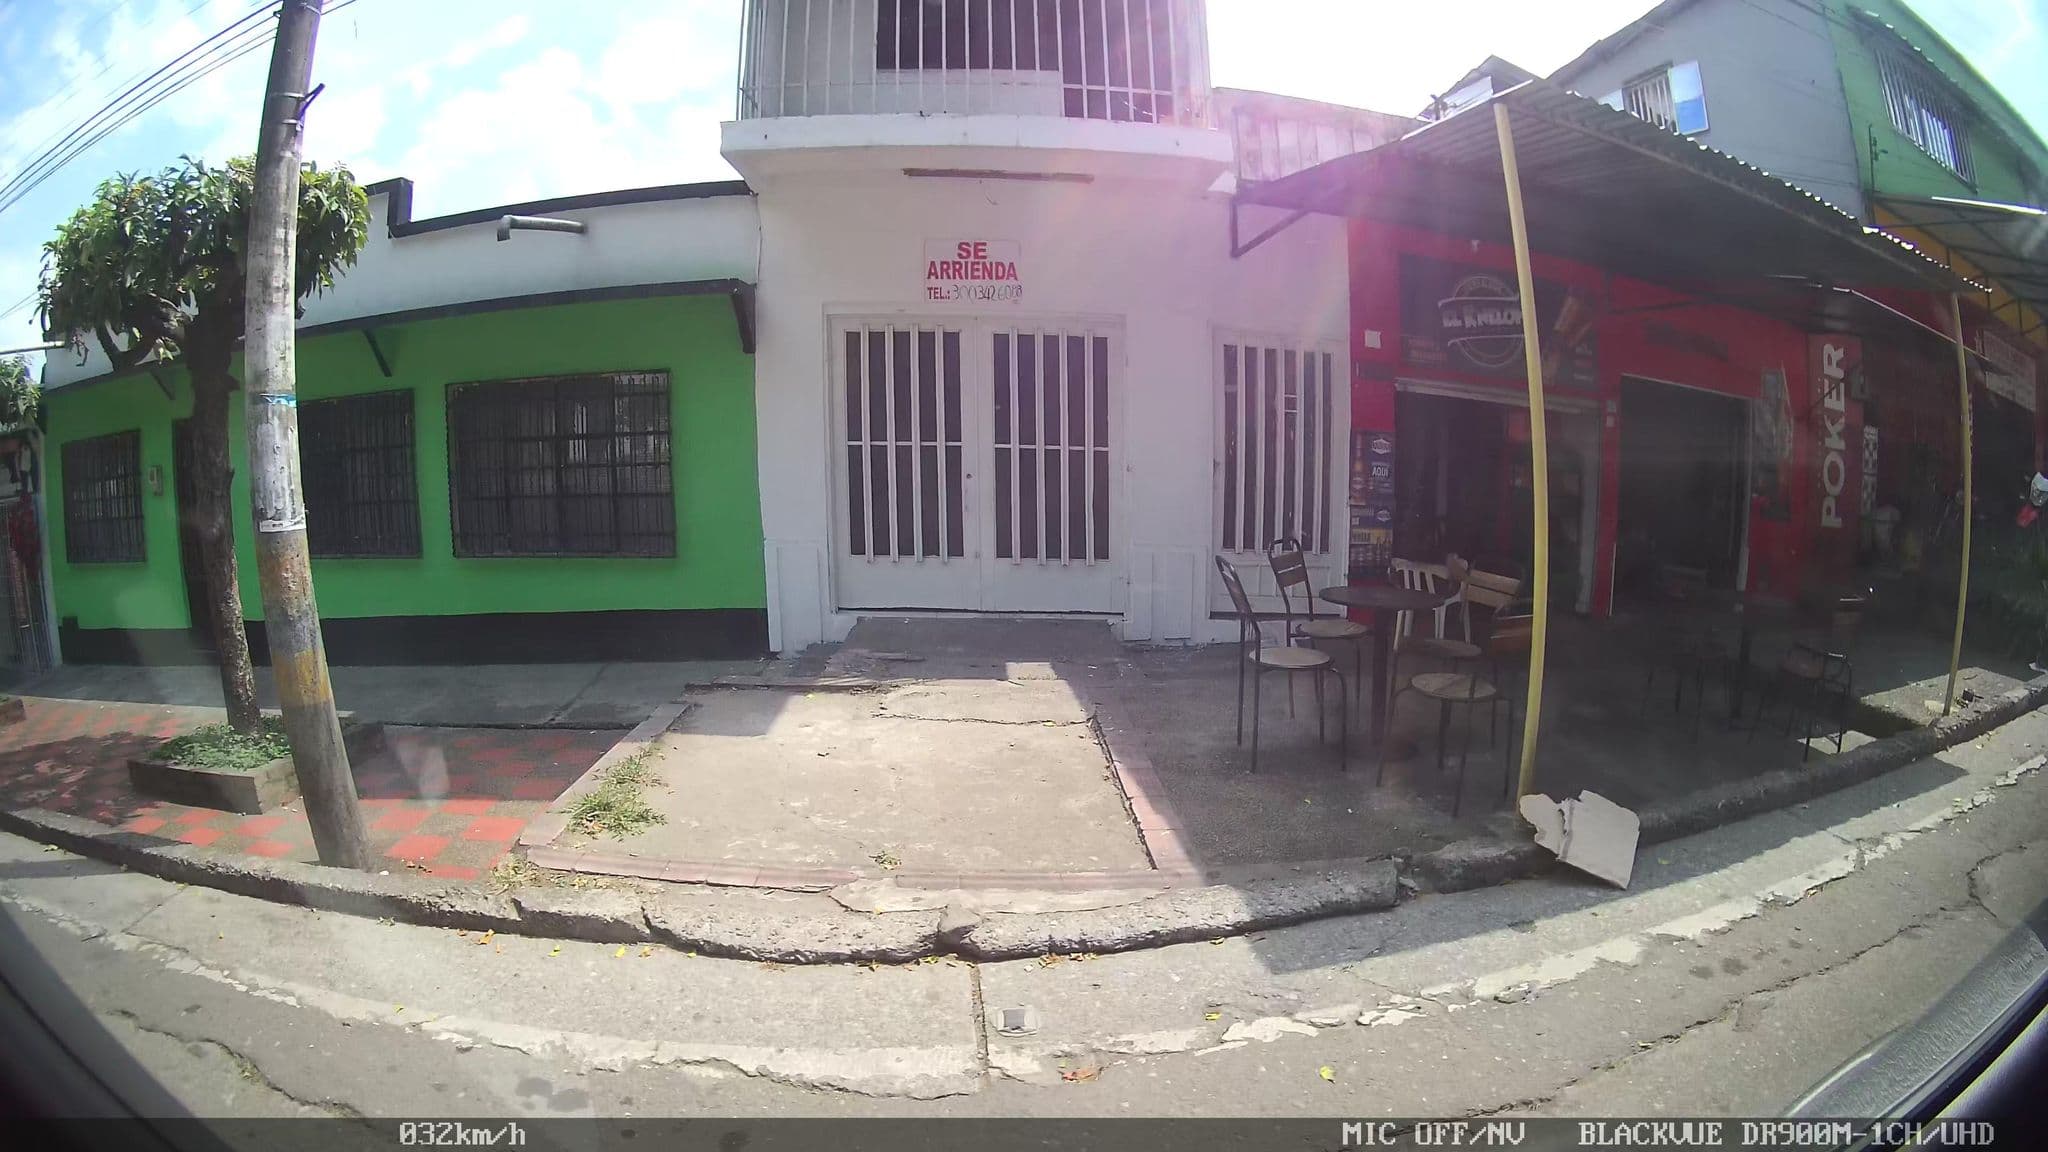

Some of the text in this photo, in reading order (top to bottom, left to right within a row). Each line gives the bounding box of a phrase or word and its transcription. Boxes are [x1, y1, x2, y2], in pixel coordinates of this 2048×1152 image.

[957, 241, 988, 259] SE
[927, 260, 1018, 281] ARRIENDA
[927, 286, 951, 300] TEL.:
[1822, 343, 1846, 528] POKER
